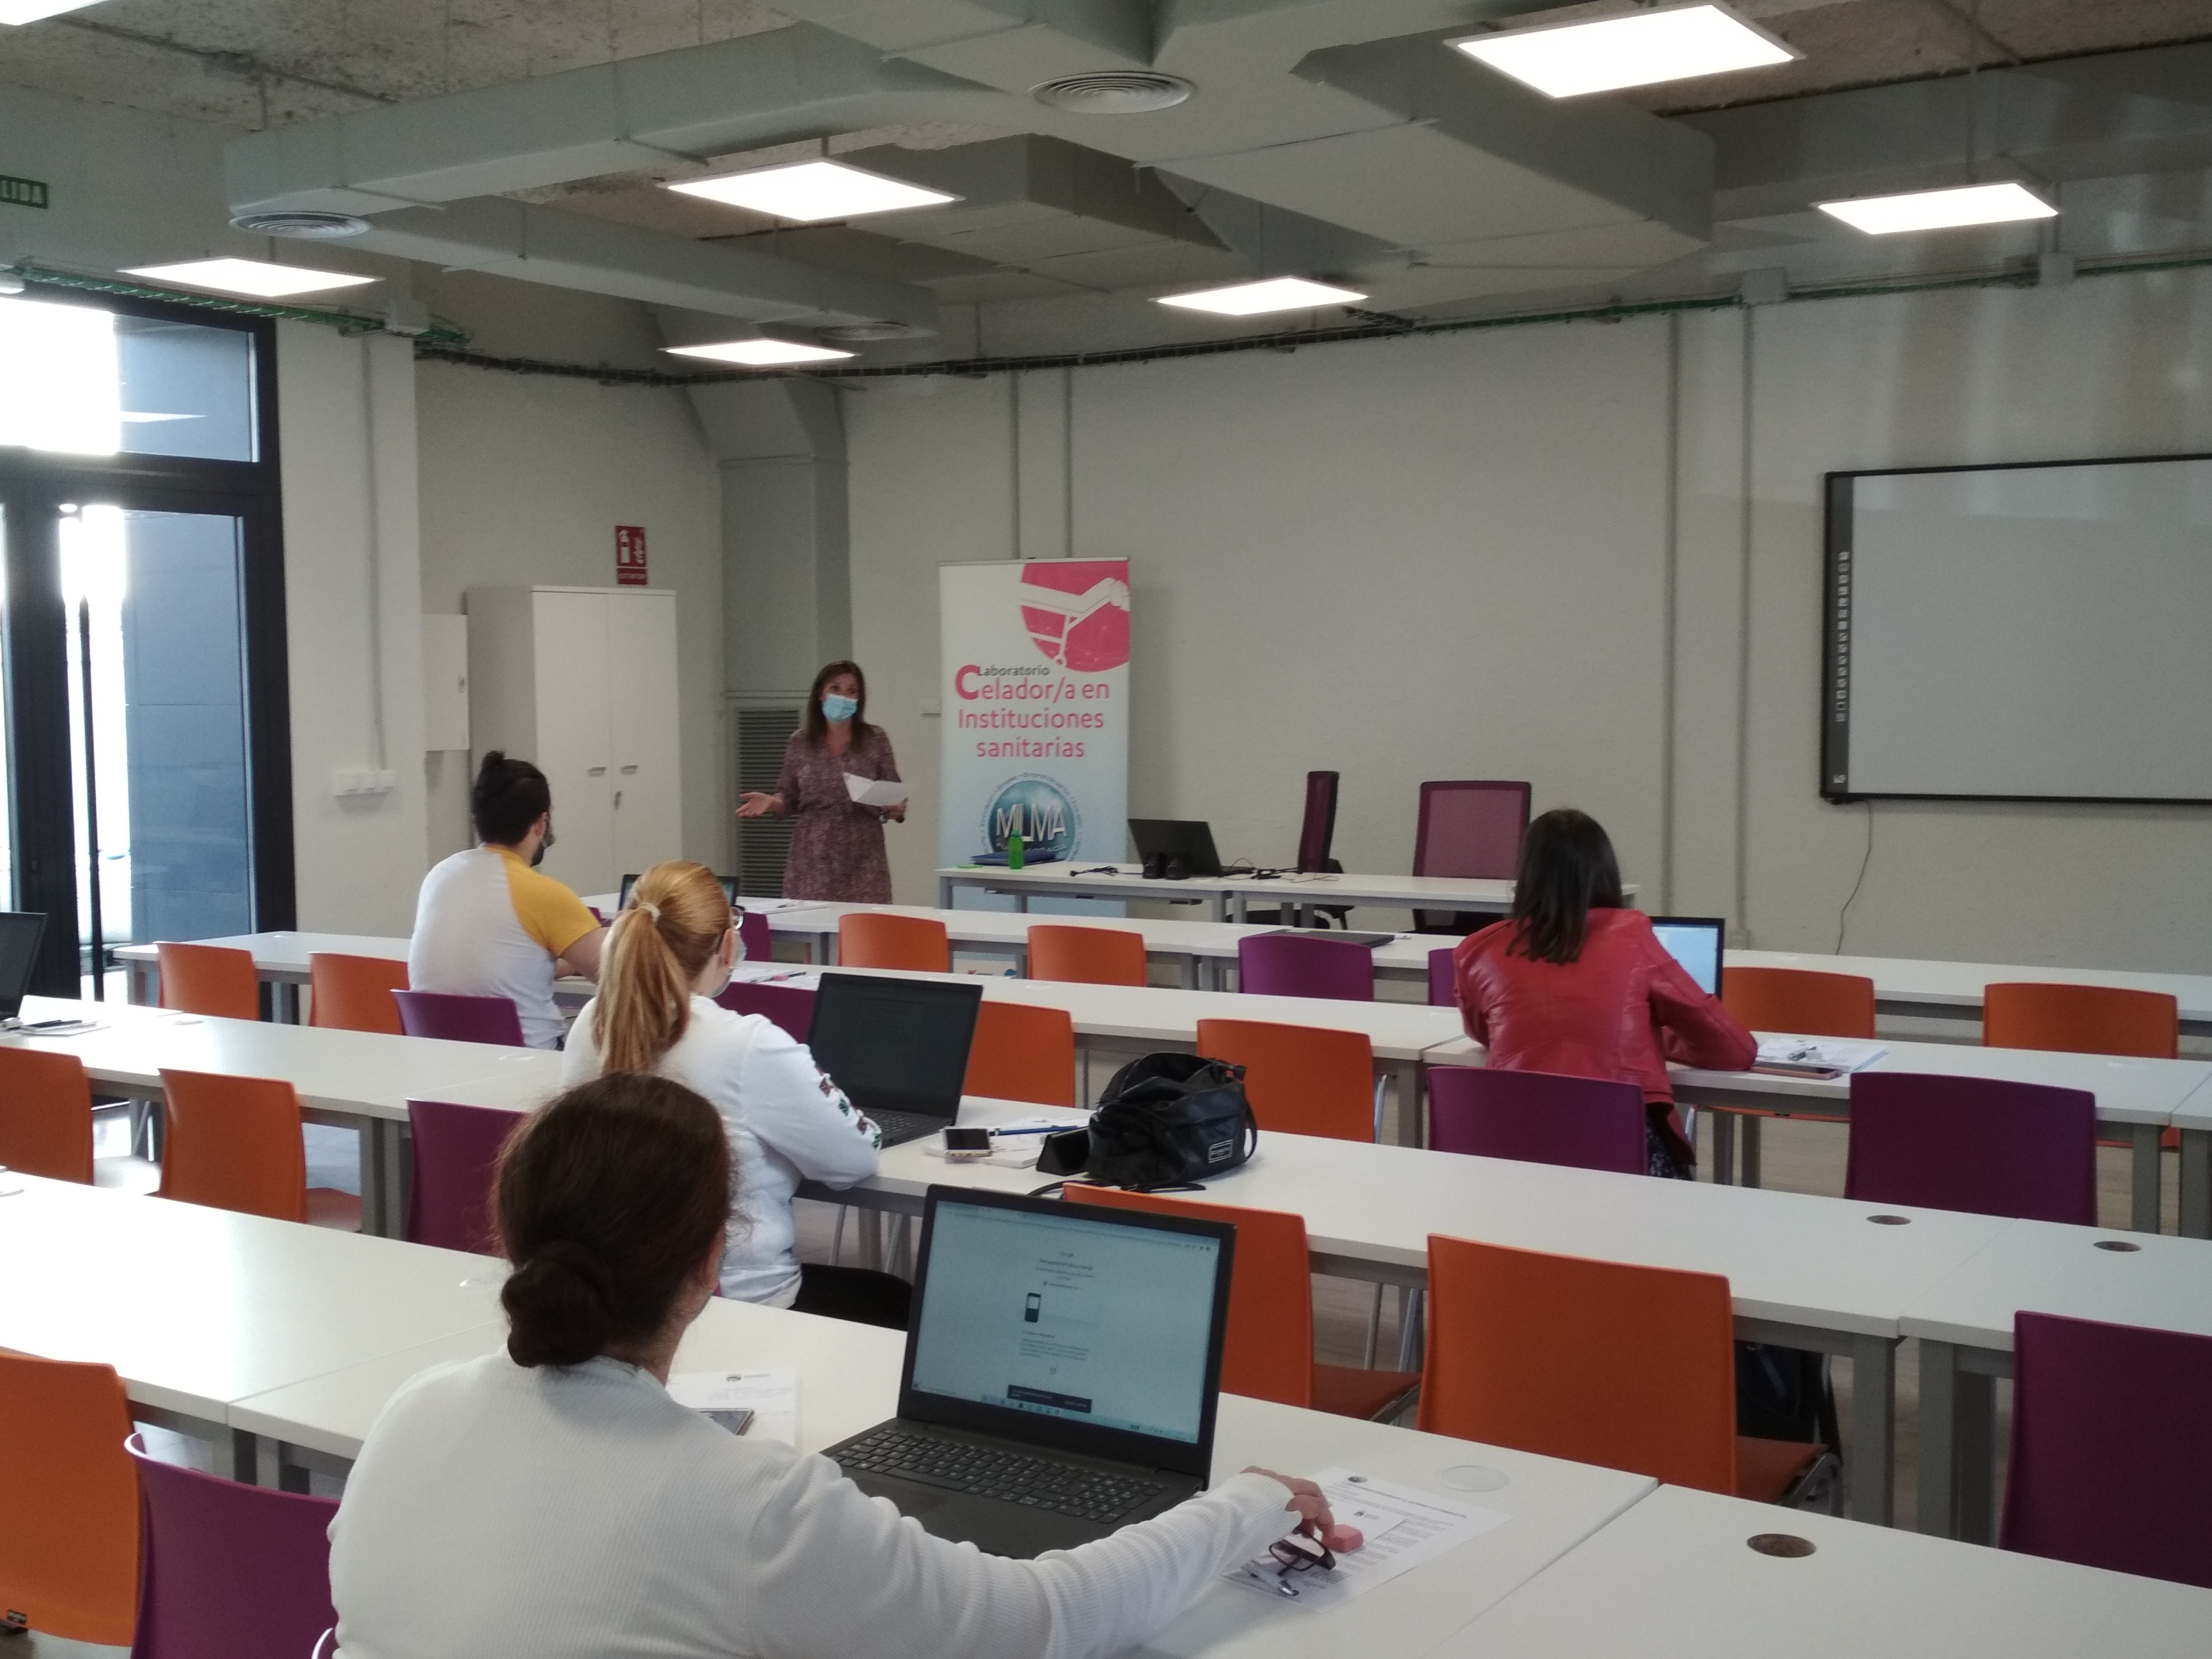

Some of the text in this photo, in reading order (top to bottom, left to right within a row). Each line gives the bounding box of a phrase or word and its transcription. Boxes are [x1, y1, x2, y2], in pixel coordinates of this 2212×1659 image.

[977, 665, 1051, 676] Laboratorio
[954, 664, 1110, 703] Celador/a en
[958, 707, 1104, 729] Instituciones
[976, 736, 1085, 758] sanitarias
